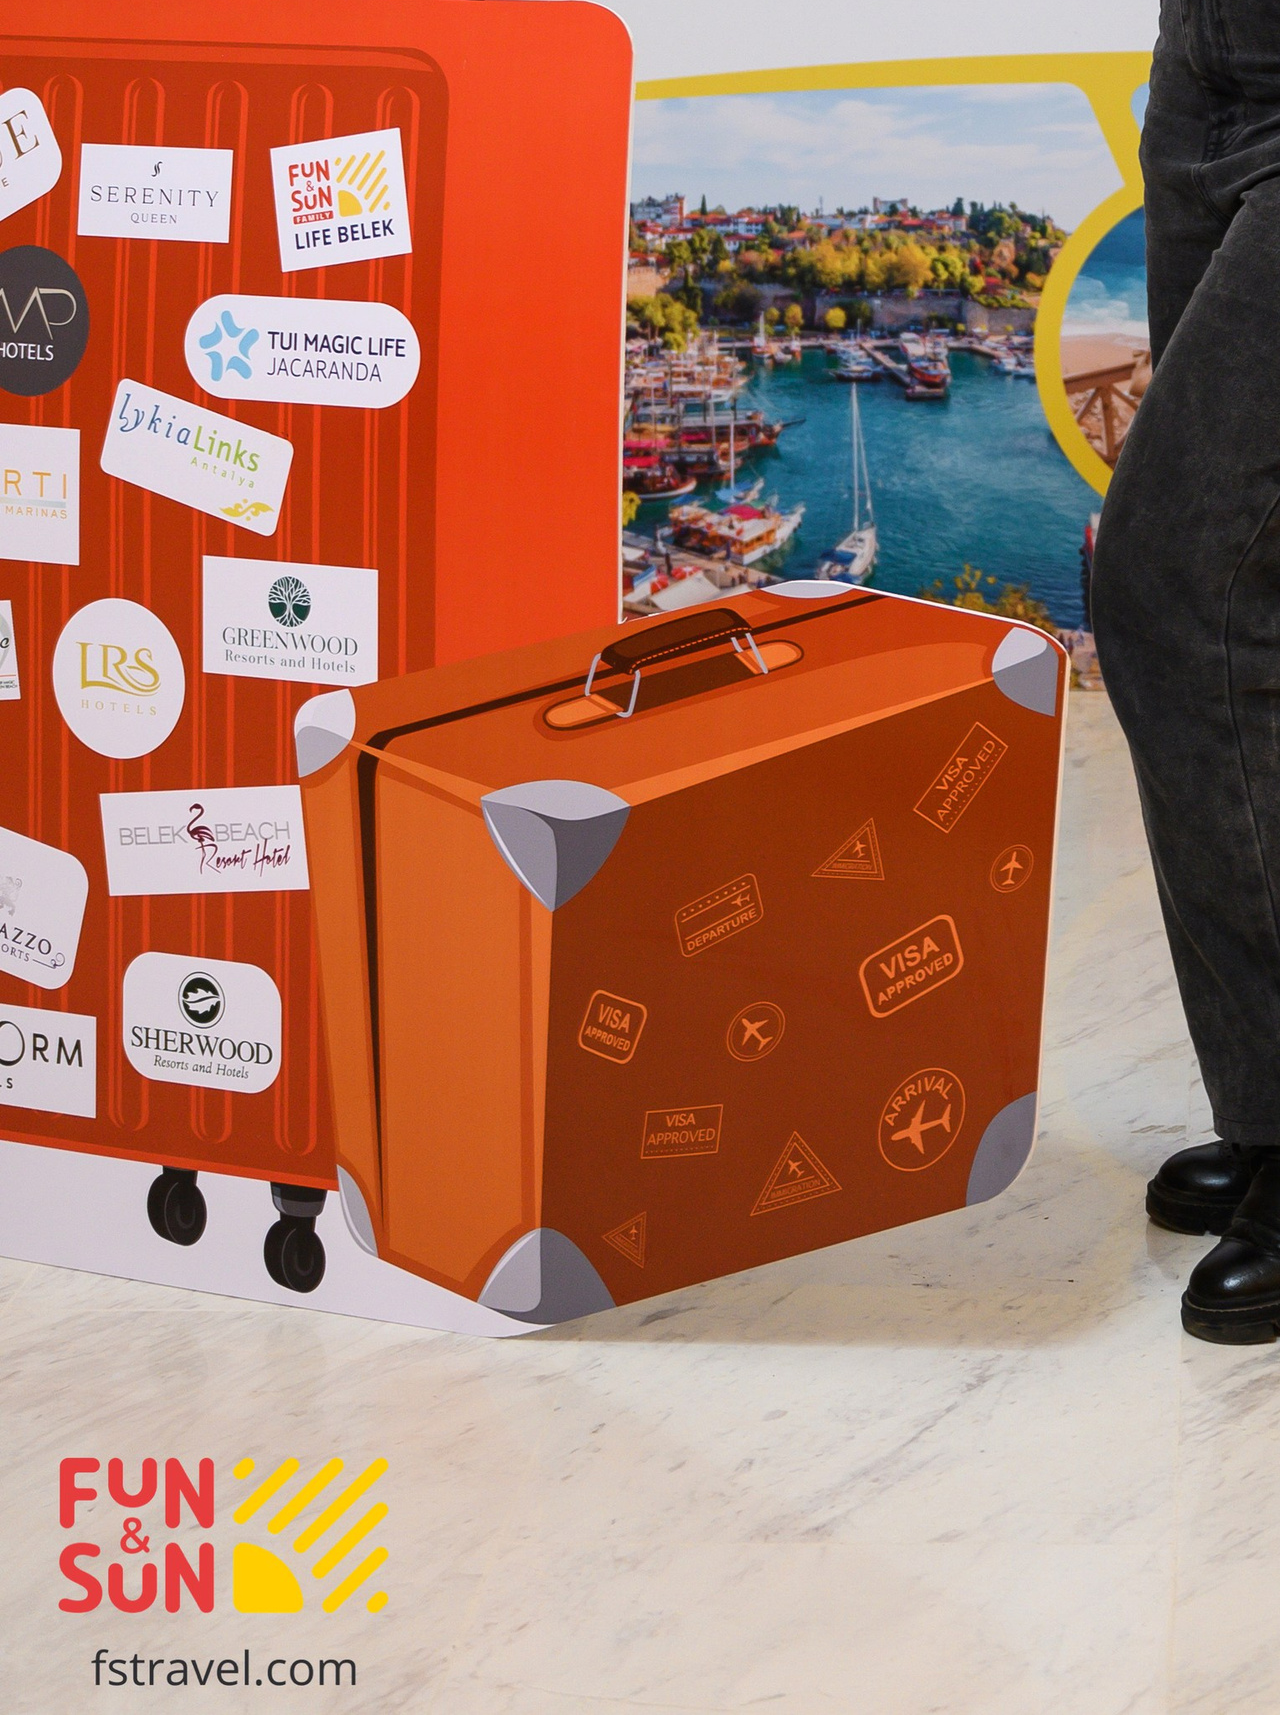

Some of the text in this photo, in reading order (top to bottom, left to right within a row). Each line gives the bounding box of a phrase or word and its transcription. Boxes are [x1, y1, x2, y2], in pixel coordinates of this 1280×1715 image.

[288, 159, 330, 187] FUN
[90, 184, 220, 208] SERENITY
[290, 185, 334, 213] SUN
[130, 212, 178, 225] QUEEN
[295, 211, 333, 224] FAMILY
[295, 218, 395, 250] LIFE BELEK
[267, 330, 406, 359] TUI MAGIC LIFE
[266, 356, 383, 383] JACARANDA
[189, 457, 256, 490] Antalya
[5, 505, 68, 520] MARINAS
[222, 626, 359, 657] GREENWOOD
[75, 641, 161, 698] LRS
[224, 649, 356, 674] Resorts and Hotels
[81, 699, 157, 717] HOTELS
[935, 738, 997, 823] APPROVED
[936, 753, 969, 793] VISA
[119, 821, 291, 846] BELEK BEACH
[686, 907, 758, 952] DEPARTURE
[878, 936, 941, 981] VISA
[876, 951, 954, 1006] APPROVED
[597, 1002, 631, 1034] VISA
[131, 1025, 273, 1066] SHERWOOD
[585, 1025, 631, 1053] APPROVED
[153, 1054, 250, 1080] Resorts and Hotels
[884, 1074, 954, 1127] ARRIVAL
[665, 1112, 696, 1127] VISA
[646, 1128, 716, 1146] APPROVED
